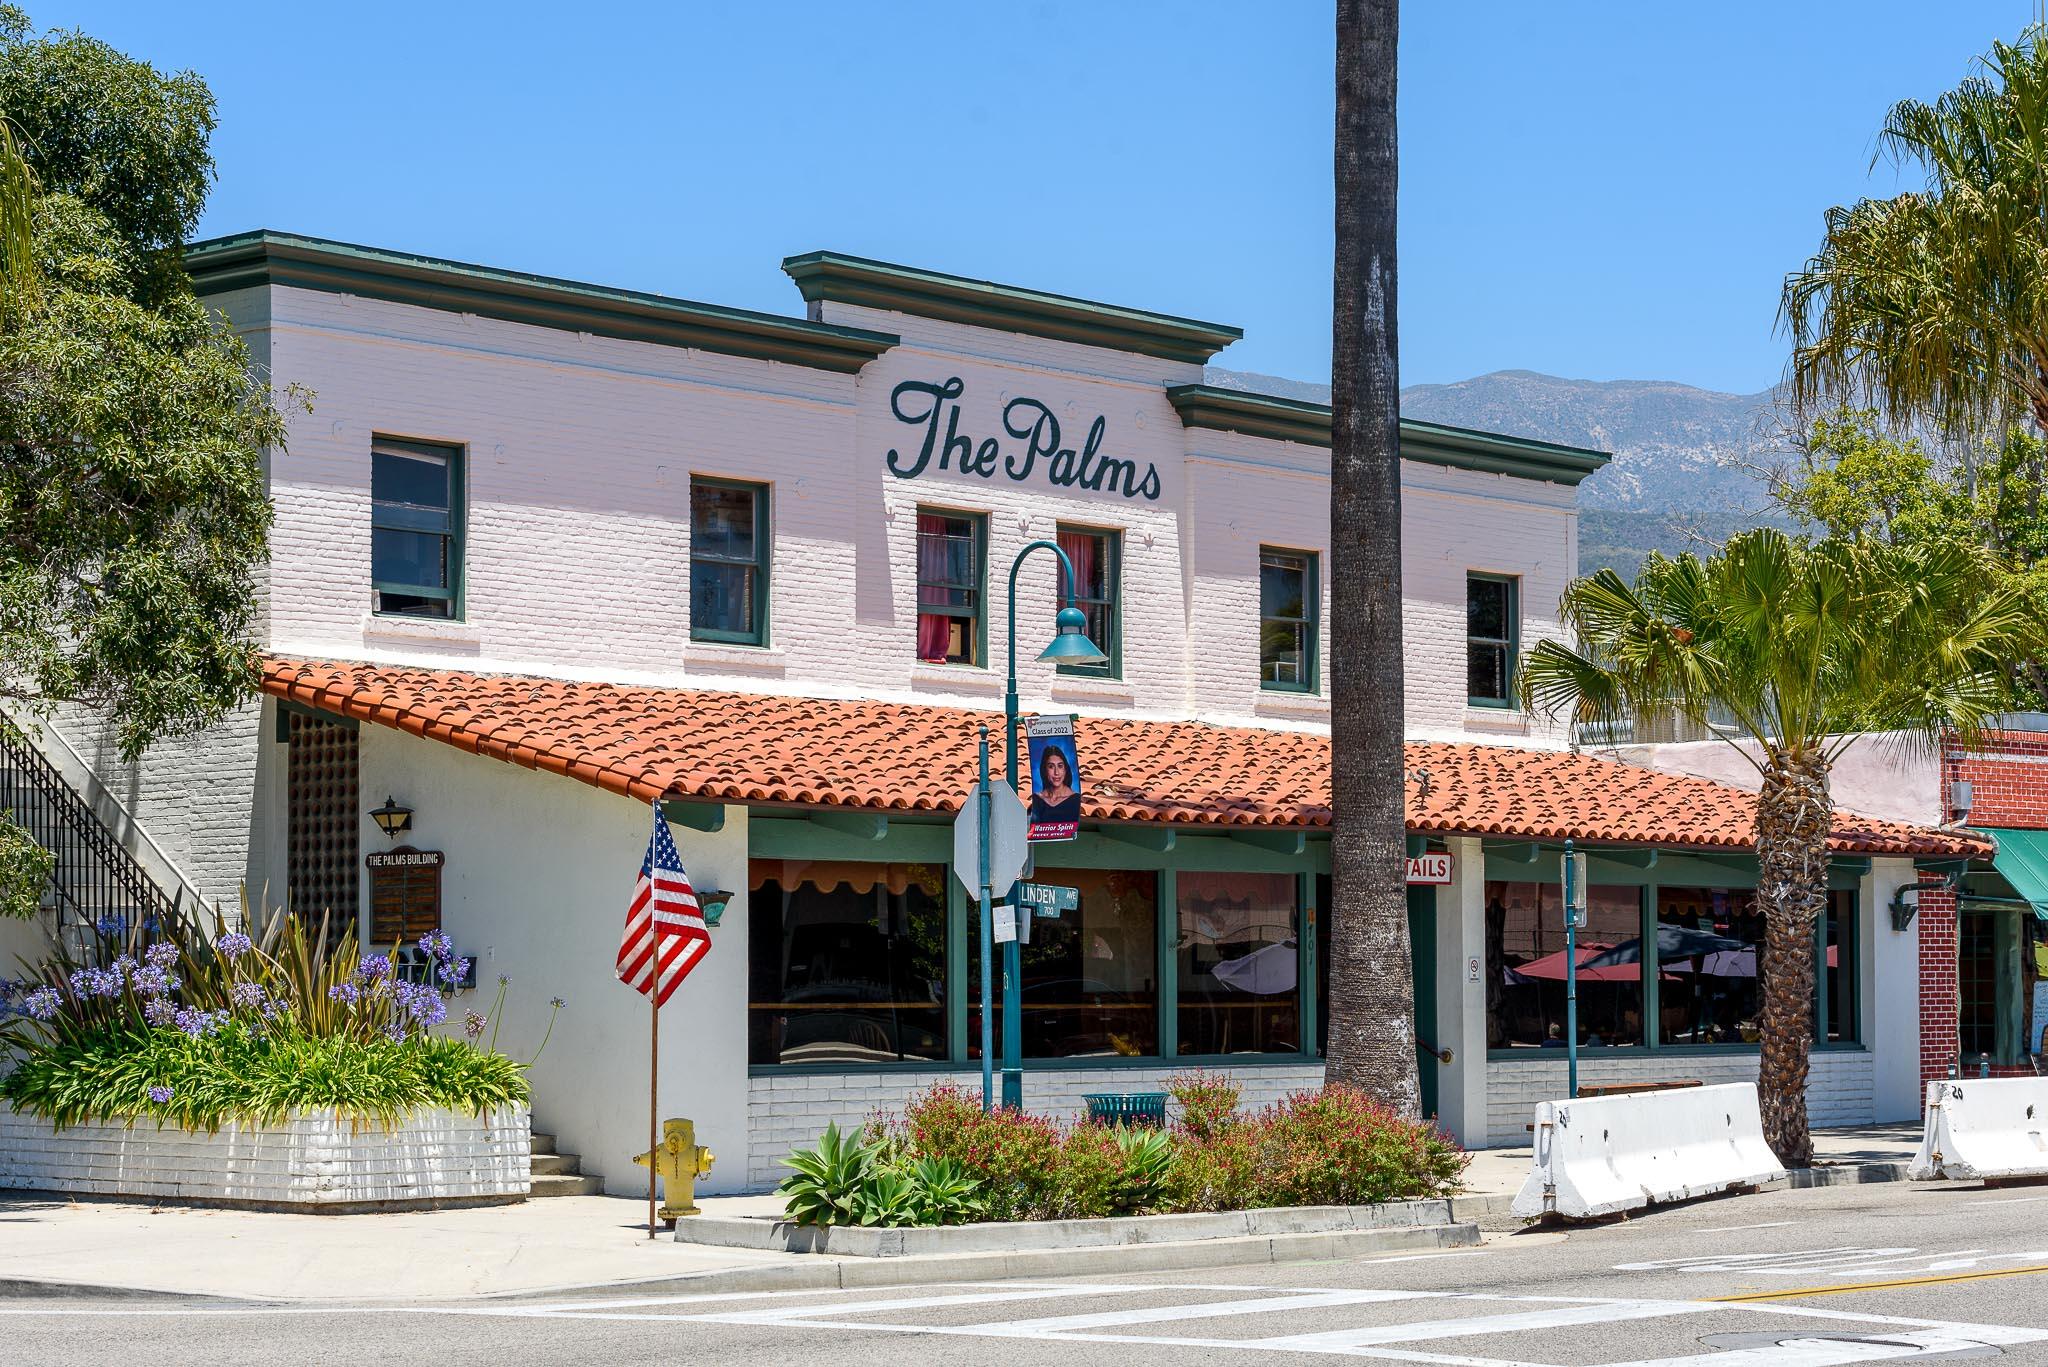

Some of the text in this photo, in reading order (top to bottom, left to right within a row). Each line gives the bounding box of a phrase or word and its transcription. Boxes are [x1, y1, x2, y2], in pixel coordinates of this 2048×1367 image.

[887, 376, 1161, 500] The Palms
[1031, 728, 1047, 736] Class
[1053, 726, 1069, 734] 2022
[1034, 823, 1074, 832] Warrior Spirit
[368, 853, 438, 866] THE PALMS BUILDING
[1021, 886, 1077, 905] LINDEN AVE
[1044, 906, 1054, 916] 700
